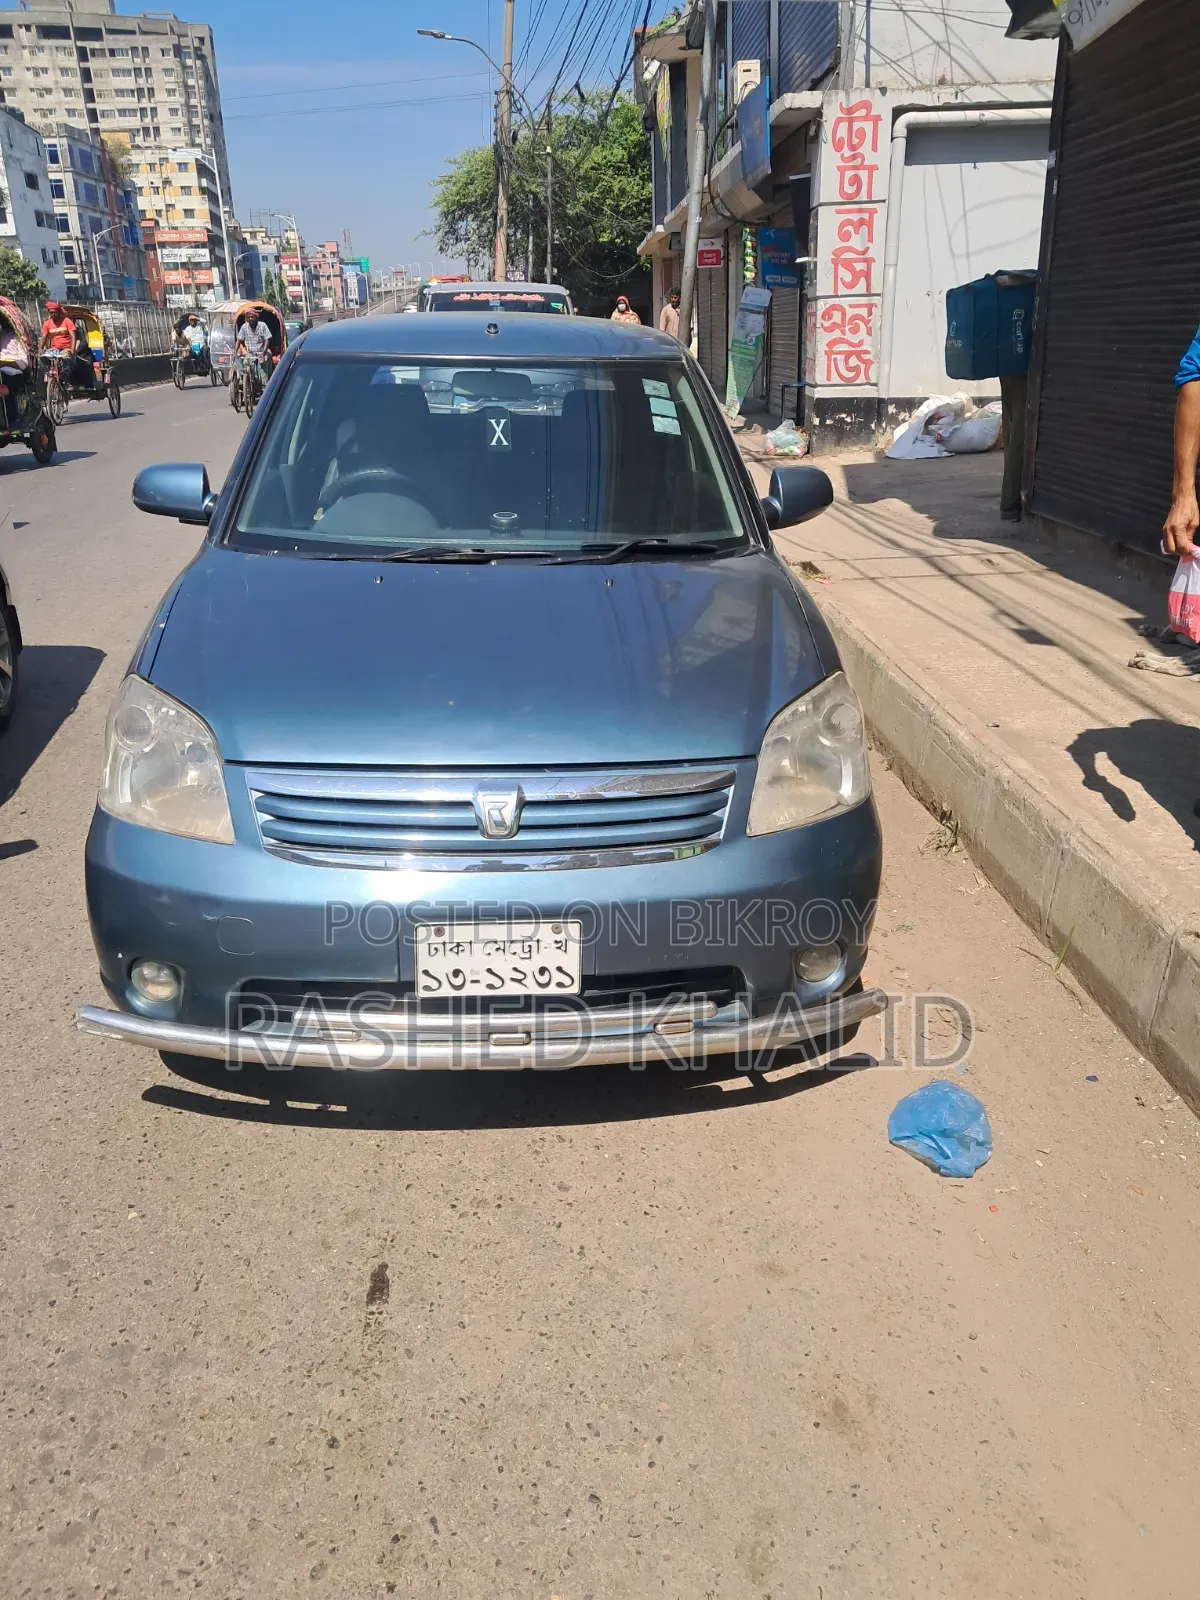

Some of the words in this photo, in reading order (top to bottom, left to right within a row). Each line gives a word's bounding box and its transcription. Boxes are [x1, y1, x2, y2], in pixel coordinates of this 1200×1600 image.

[488, 418, 509, 446] X
[427, 940, 473, 958] ঢাকা
[421, 965, 575, 993] ১৩-১২৩১
